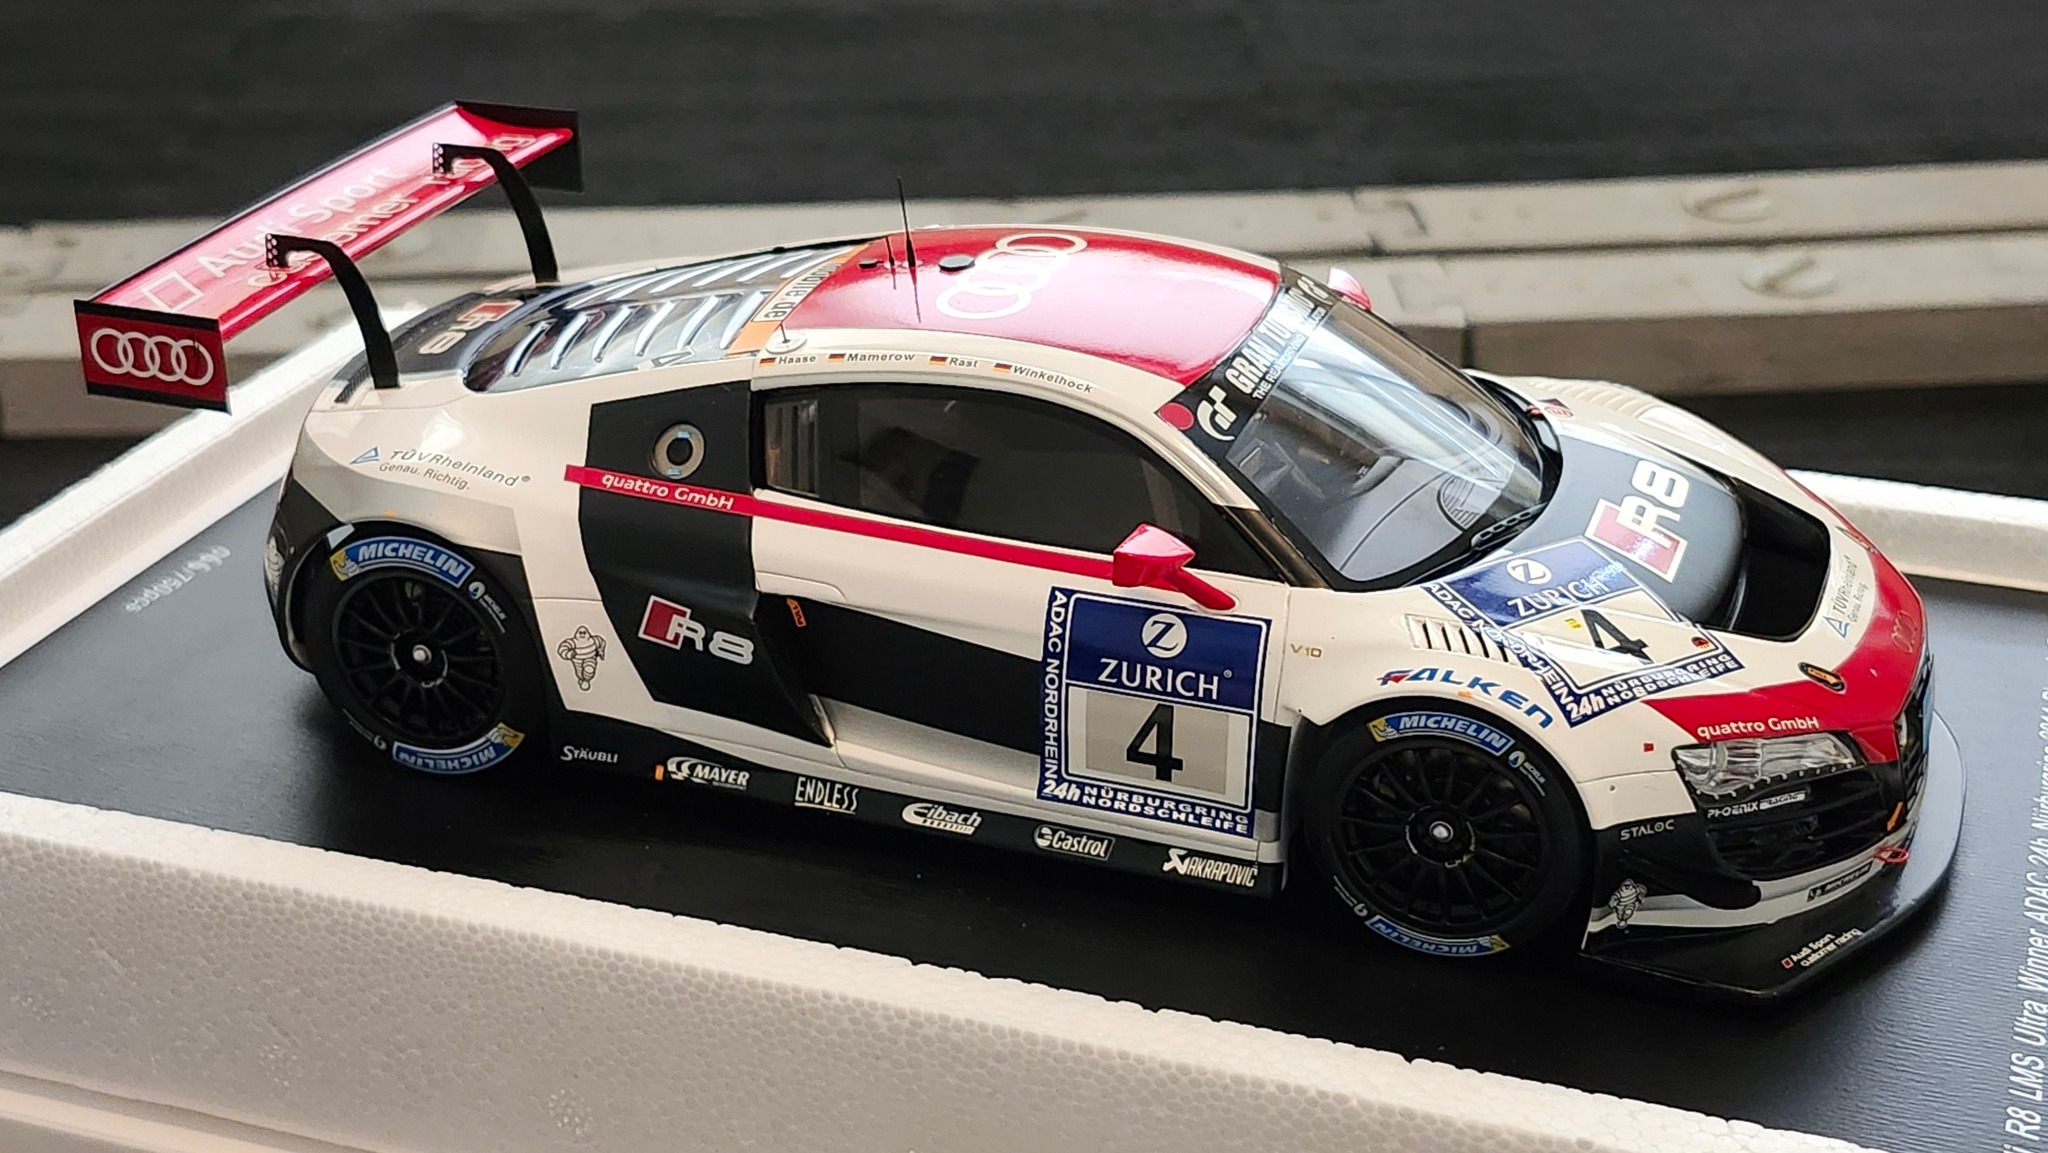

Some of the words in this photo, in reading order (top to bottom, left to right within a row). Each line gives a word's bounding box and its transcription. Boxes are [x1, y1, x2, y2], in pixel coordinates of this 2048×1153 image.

[288, 166, 408, 223] Sport
[247, 193, 420, 287] cusomer
[779, 354, 816, 365] Haase
[847, 352, 915, 362] Mamerow
[949, 357, 978, 368] Rast
[1226, 336, 1281, 394] GRAN
[1011, 365, 1093, 393] Winkelhock
[1252, 378, 1273, 400] THE
[379, 462, 420, 477] Genau.
[423, 467, 470, 490] Richtig.
[601, 474, 669, 497] quattro
[674, 486, 734, 510] GmbH
[1600, 460, 1689, 566] R8
[358, 541, 465, 578] MICHELIN
[1425, 582, 1475, 619] ADAC
[1507, 575, 1610, 617] ZURICH
[652, 604, 754, 665] R8
[1047, 591, 1068, 652] ADAC
[1580, 609, 1653, 664] 4
[1290, 644, 1322, 658] V10
[1097, 658, 1219, 700] ZURICH
[1566, 692, 1605, 719] 24h
[1601, 653, 1732, 697] NÜRBURGRING
[1377, 668, 1553, 729] FALKEN
[1044, 658, 1060, 779] NORDRHEIN
[1399, 715, 1507, 748] MICHELIN
[1697, 720, 1765, 739] quattro
[1767, 716, 1819, 731] GmbH
[399, 745, 498, 770] MICHELIN
[561, 746, 618, 763] STÄUBLI
[1126, 703, 1183, 782] 4
[693, 763, 750, 786] MAYER
[795, 777, 859, 812] ENDLESS
[1043, 779, 1082, 801] 24h
[1083, 785, 1249, 824] NÜRBURGRING
[1707, 801, 1759, 818] PHOENIX
[902, 802, 982, 827] Eibach
[1082, 796, 1248, 834] NORDSCHLEIFE
[1620, 819, 1675, 841] STALOC
[1052, 830, 1108, 857] Castrol
[2023, 871, 2048, 925] ADAC
[1374, 922, 1479, 954] MICHELIN
[1790, 946, 1812, 962] Audi
[1808, 934, 1836, 950] Sport
[2017, 927, 2048, 992] Winner
[2013, 1000, 2048, 1046] Ultra
[2008, 1053, 2045, 1102] LMS
[2005, 1106, 2041, 1141] R8
